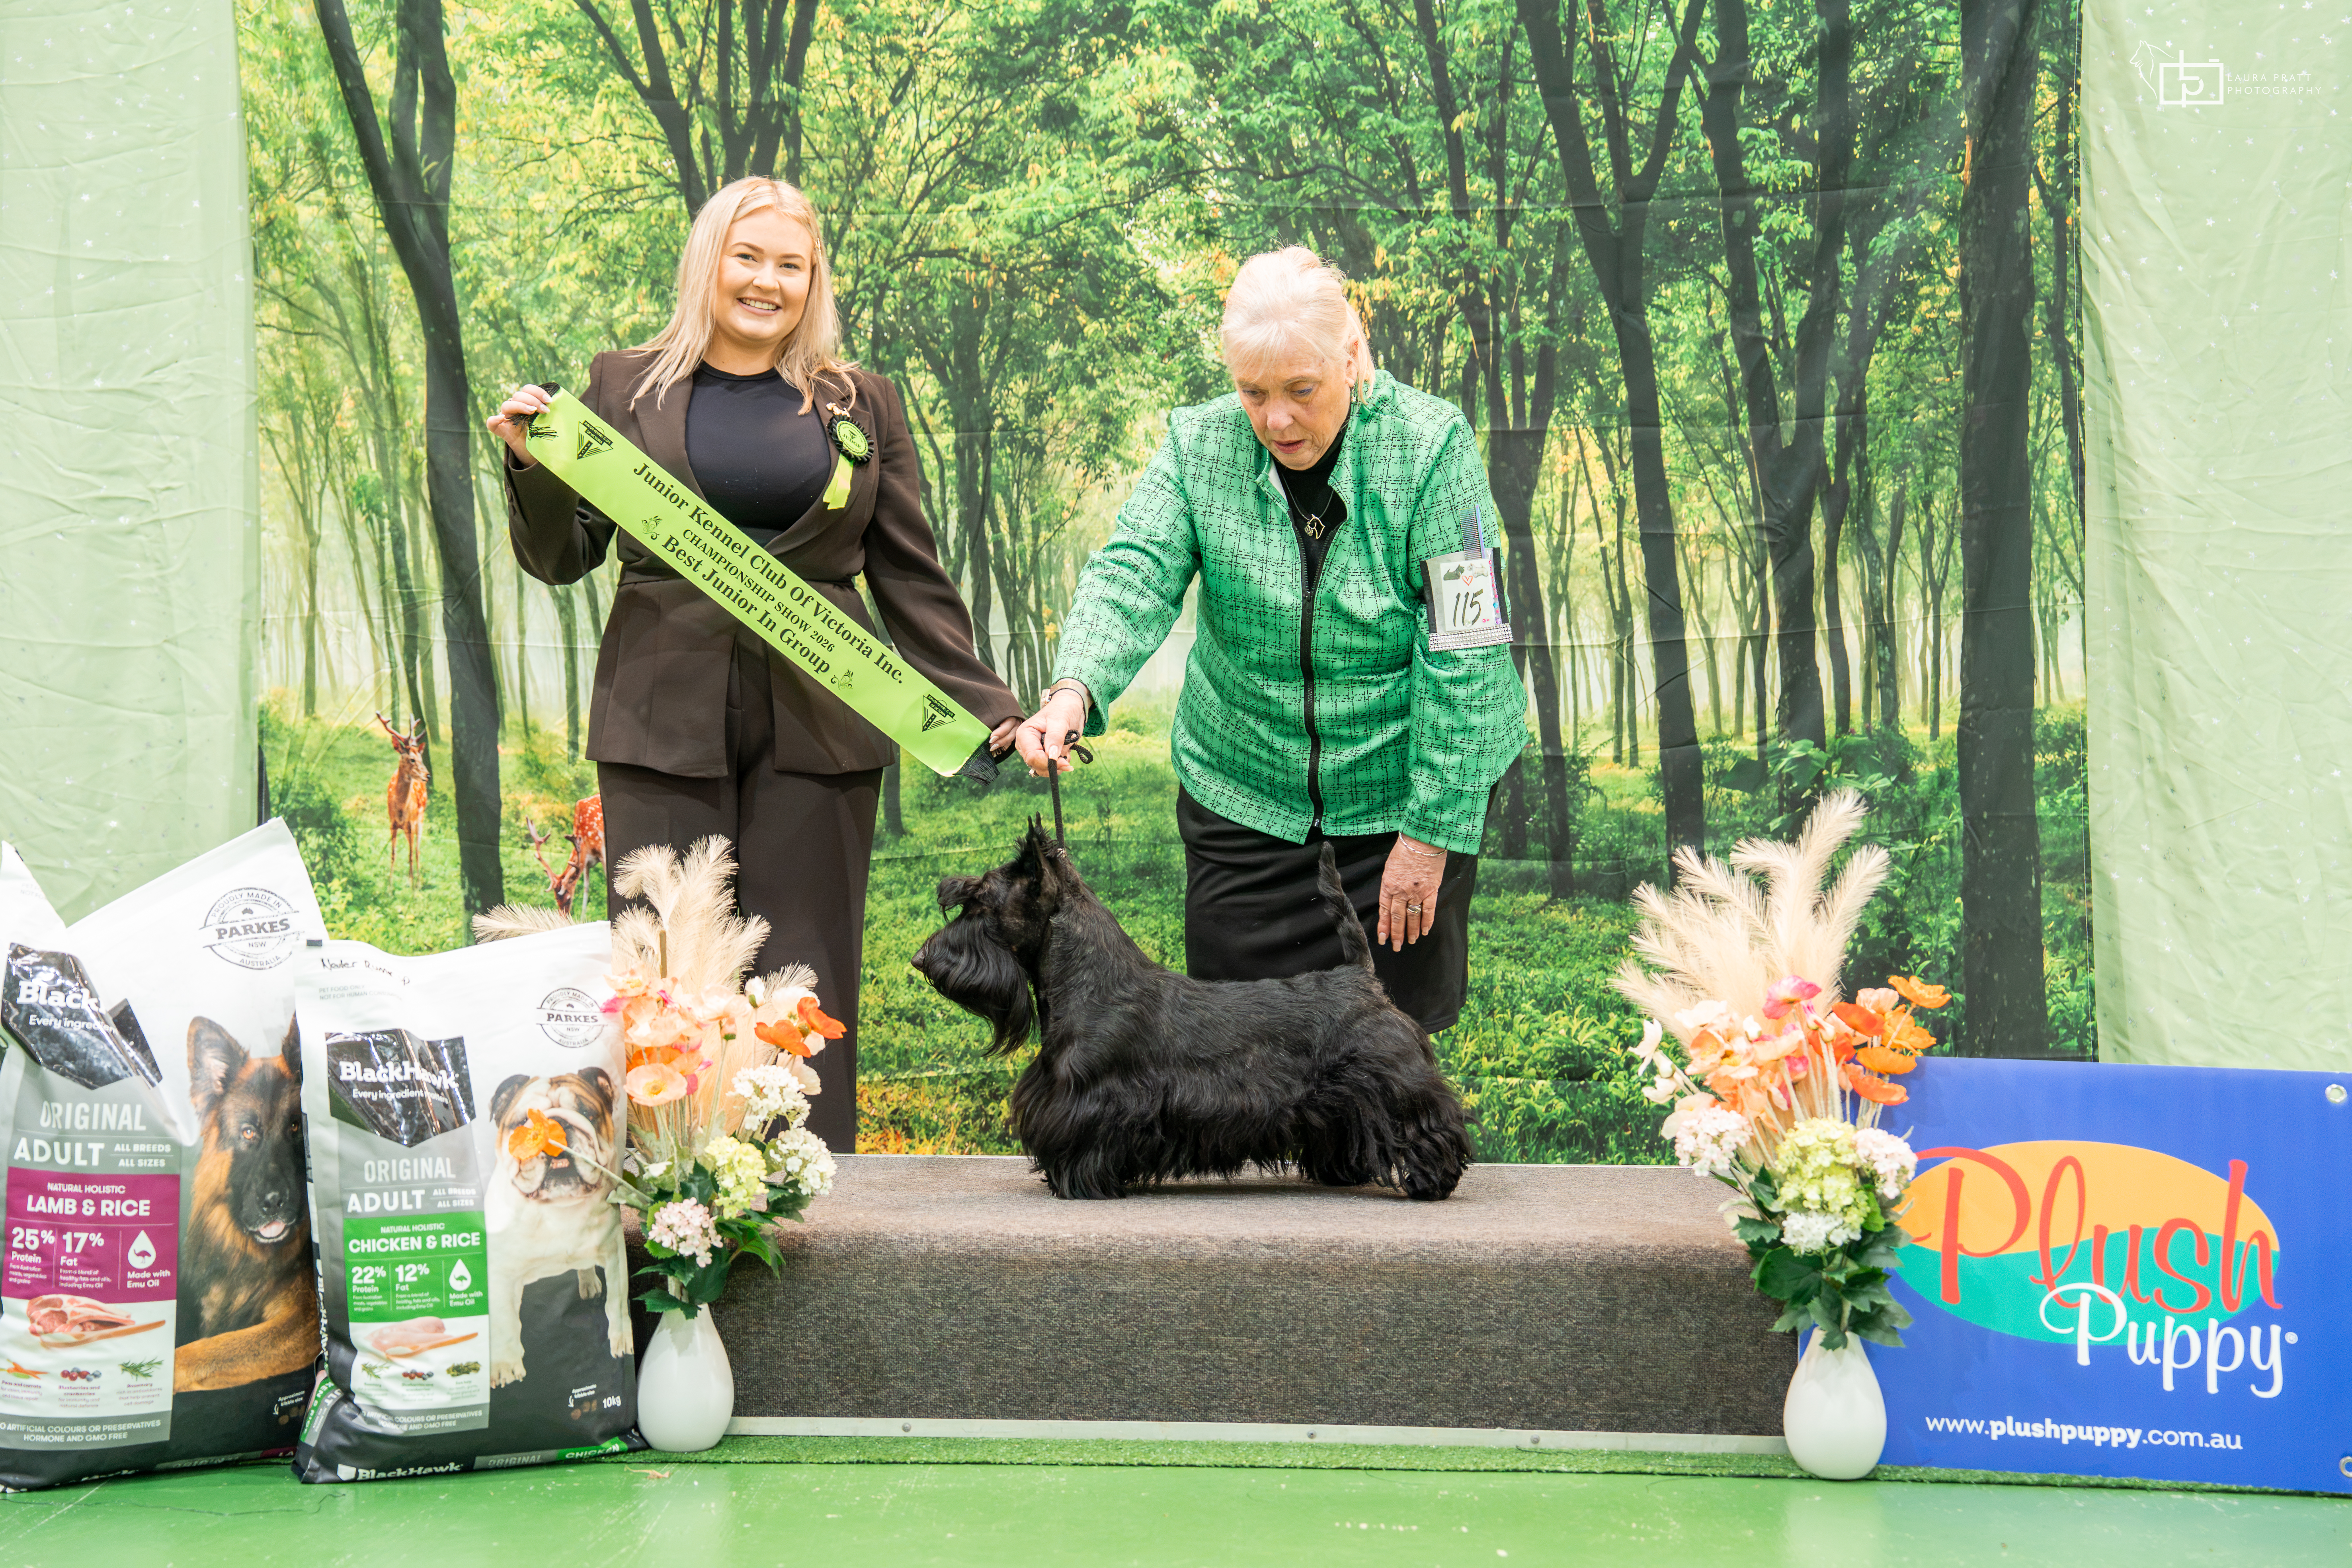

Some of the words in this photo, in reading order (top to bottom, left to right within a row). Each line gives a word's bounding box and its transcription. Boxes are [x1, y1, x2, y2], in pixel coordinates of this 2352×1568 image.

[842, 433, 861, 449] JUDGE
[634, 463, 689, 510] Junior
[688, 505, 750, 558] Kennel
[750, 555, 787, 589] Club
[790, 586, 814, 608] Of
[814, 601, 872, 658] Victoria
[874, 652, 902, 684] Inc.
[683, 529, 775, 603] CHAMPIONSHIP
[774, 601, 812, 632] SHOW
[810, 630, 835, 652] 2026
[662, 535, 703, 572] Best
[702, 568, 757, 615] Junior
[757, 609, 777, 632] In
[779, 628, 830, 674] Group
[1453, 588, 1483, 627] 115
[211, 892, 243, 917] PROUDLY
[247, 892, 271, 902] MADE
[273, 900, 282, 908] IN
[215, 918, 290, 939] PARKES
[240, 955, 281, 967] AUSTRALIA
[16, 980, 107, 1014] Black
[547, 991, 570, 1004] PROUDLY
[572, 992, 588, 1002] MADE
[29, 1014, 62, 1030] Every
[547, 1012, 598, 1023] PARKES
[339, 1060, 459, 1090] BlackHawk
[353, 1088, 378, 1101] Every
[379, 1089, 424, 1102] ingredient
[40, 1100, 147, 1131] ORIGINAL
[14, 1137, 105, 1166] ADULT
[114, 1144, 131, 1152] ALL
[133, 1144, 171, 1153] BREEDS
[119, 1158, 135, 1167] ALL
[137, 1159, 166, 1167] SIZES
[364, 1157, 456, 1183] ORIGINAL
[47, 1182, 83, 1193] NATURAL
[84, 1185, 126, 1194] HOLISTIC
[27, 1195, 77, 1215] LAMB
[82, 1199, 96, 1216] &
[101, 1199, 150, 1216] RICE
[347, 1189, 426, 1213] ADULT
[412, 1222, 445, 1232] HOLISTIC
[1910, 1146, 2284, 1314] Plush
[12, 1226, 55, 1250] 25%
[62, 1231, 104, 1253] 17%
[349, 1236, 422, 1253] CHICKEN
[426, 1235, 437, 1249] &
[441, 1232, 480, 1248] RICE
[11, 1251, 42, 1263] Protein
[60, 1256, 78, 1266] Fat
[127, 1280, 146, 1288] Emu
[351, 1265, 387, 1284] 22%
[395, 1263, 430, 1283] 12%
[352, 1285, 379, 1293] Protein
[395, 1283, 410, 1292] Fat
[2039, 1281, 2284, 1399] Puppy
[602, 1395, 622, 1409] 10kg
[0, 1422, 6, 1430] O
[7, 1424, 46, 1433] ARTIFICIAL
[102, 1419, 161, 1432] PRESERVATIVES
[394, 1415, 425, 1423] COLOURS
[437, 1410, 483, 1420] PRESERVATIVES
[23, 1433, 64, 1443] HORMONE
[66, 1434, 84, 1442] AND
[85, 1433, 107, 1441] GMO
[108, 1431, 128, 1440] FREE
[1925, 1415, 2243, 1450] www.plushpuppy.com.au
[357, 1462, 461, 1480] BlackHawk
[488, 1455, 541, 1468] ORIGINAL
